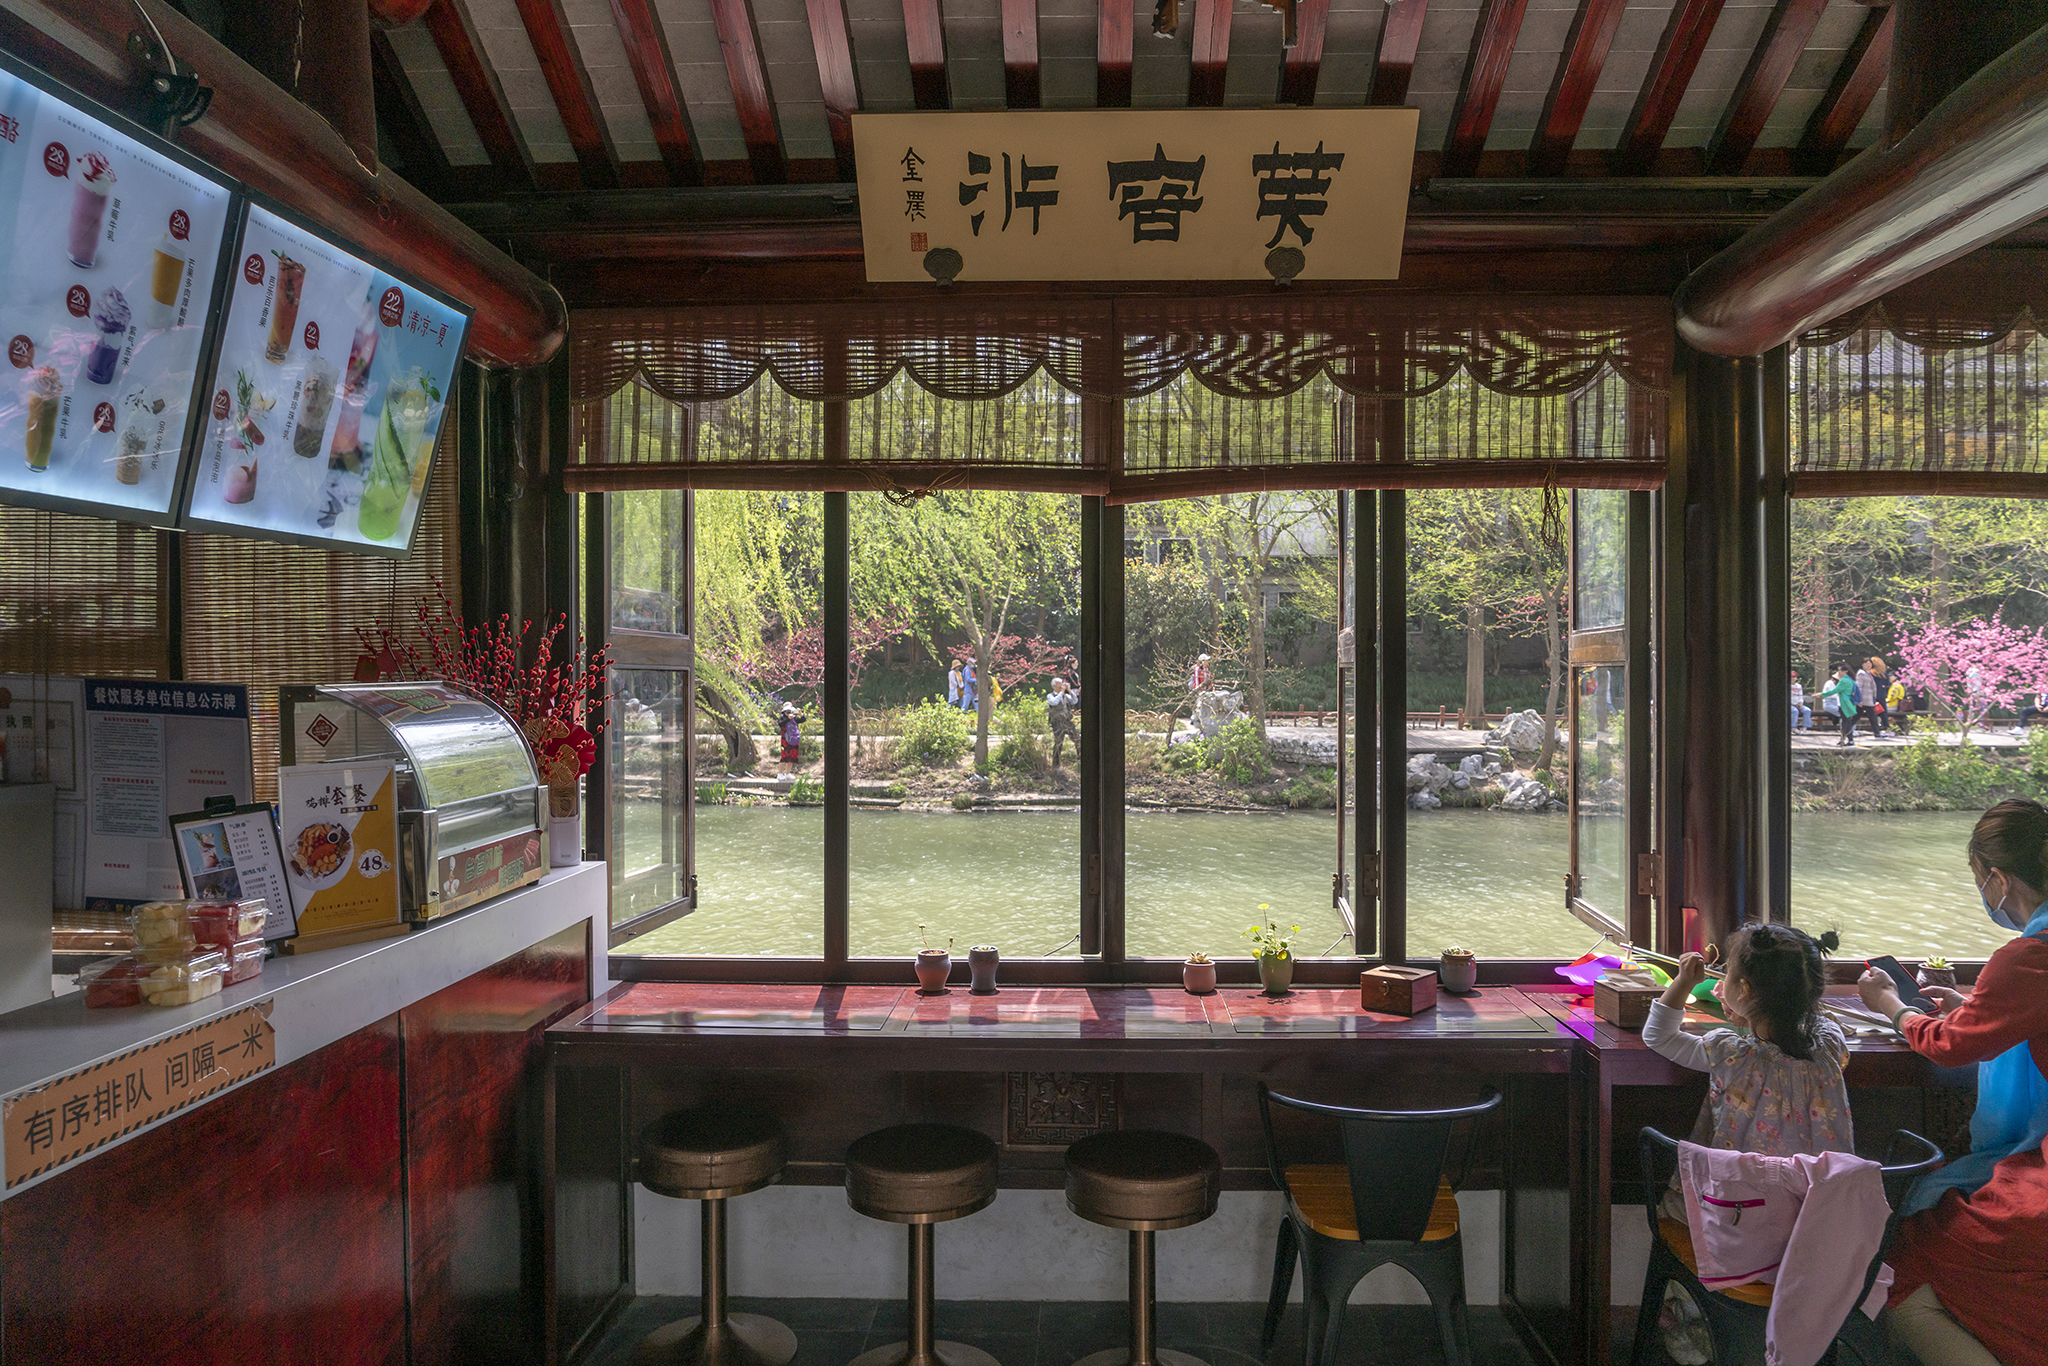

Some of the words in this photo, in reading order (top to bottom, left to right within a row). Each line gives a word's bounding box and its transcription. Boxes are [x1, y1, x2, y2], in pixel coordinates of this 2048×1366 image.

[48, 146, 64, 163] 28
[173, 214, 185, 229] 28
[248, 258, 261, 273] 22
[72, 290, 85, 305] 28
[384, 291, 400, 311] 22
[307, 326, 317, 340] 22
[406, 310, 450, 348] 清凉一夏
[14, 340, 29, 356] 28
[94, 686, 236, 711] 餐饮服务单位信息公示牌
[360, 855, 383, 871] 48
[24, 1068, 152, 1155] 有序排队
[165, 1023, 264, 1095] 间隔一米
